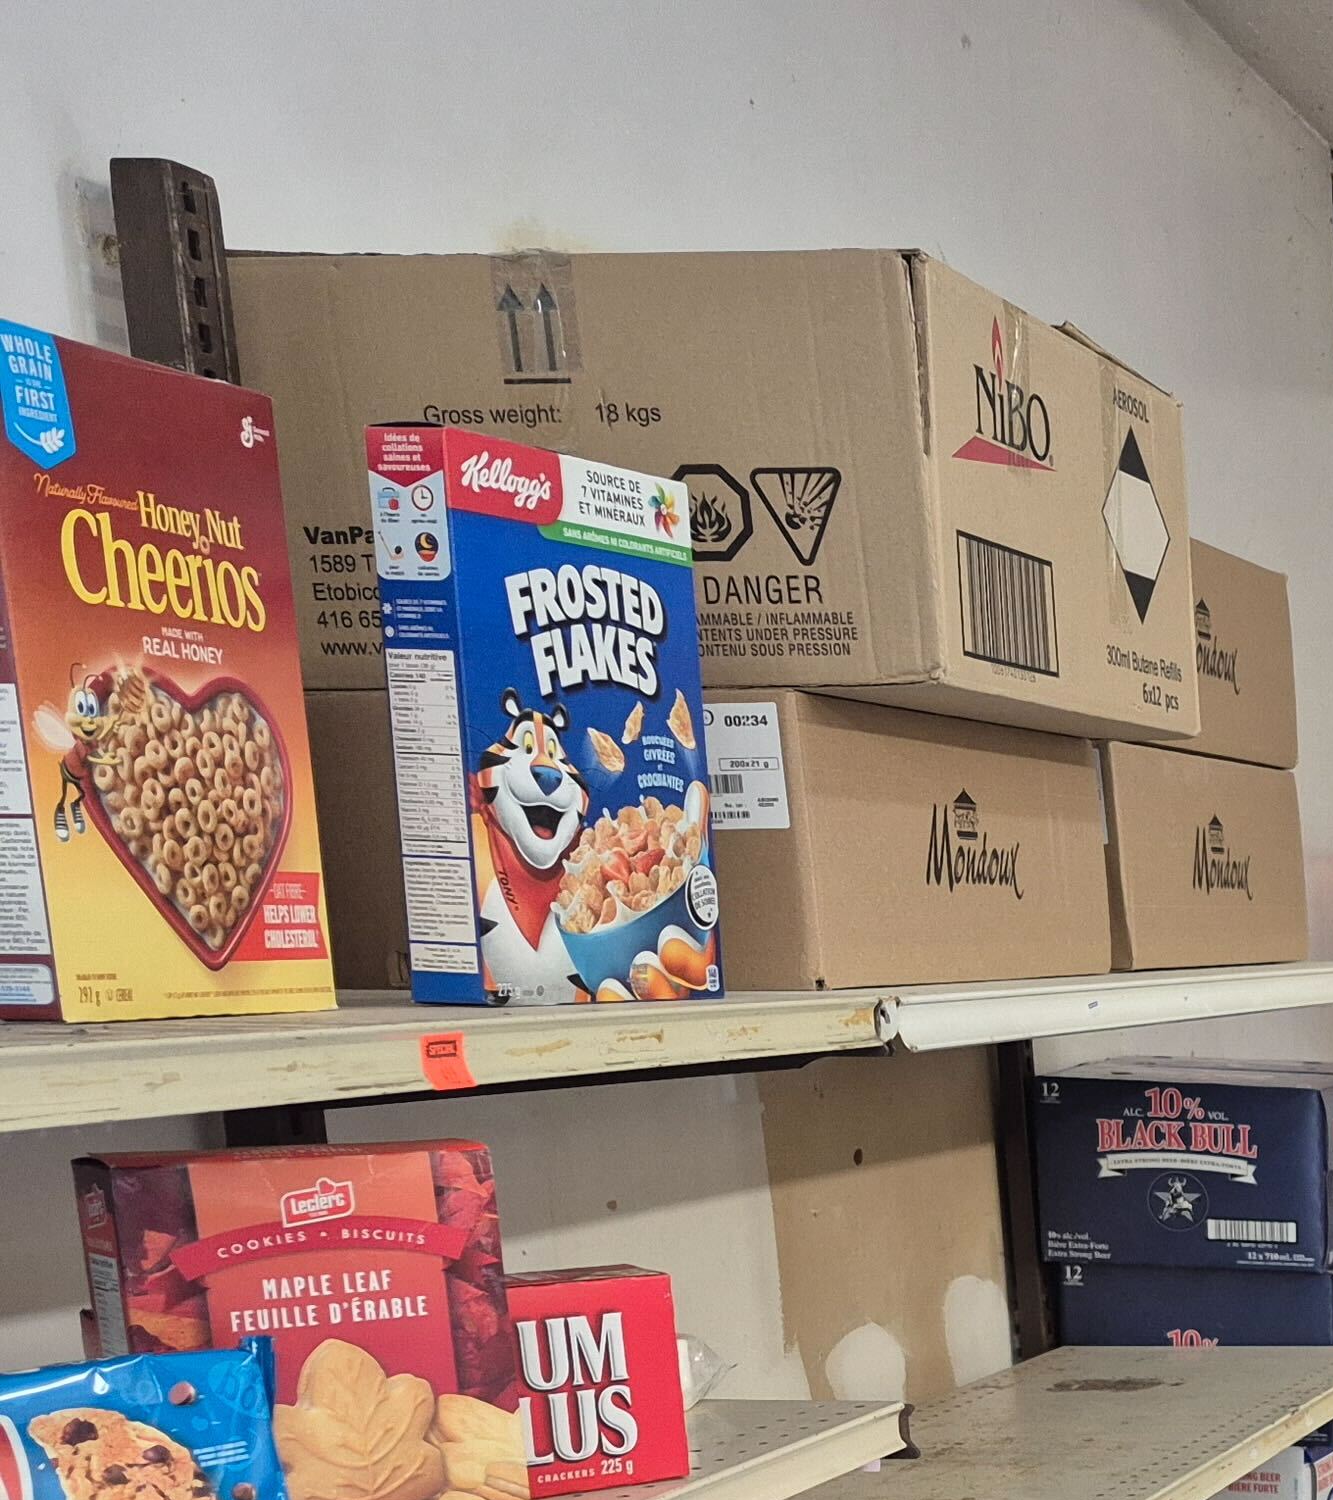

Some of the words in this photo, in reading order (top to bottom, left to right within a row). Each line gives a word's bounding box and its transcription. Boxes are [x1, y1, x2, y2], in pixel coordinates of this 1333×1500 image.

[1, 333, 52, 364] WHOLE
[9, 354, 52, 381] GRAIN
[15, 387, 55, 411] FIRST
[1112, 388, 1150, 424] AEROSOL
[423, 404, 485, 425] Gross
[489, 404, 562, 427] weight:
[595, 405, 619, 423] 18
[626, 403, 662, 426] kgs
[461, 451, 552, 510] Kellogg's
[586, 470, 624, 491] SOURCE
[627, 480, 641, 494] DE
[137, 490, 200, 548] Honey
[205, 507, 244, 550] Nut
[61, 508, 266, 632] Cheerios
[309, 555, 361, 574] 1589
[504, 564, 664, 636] FROSTED
[703, 575, 823, 605] DANGER
[317, 611, 357, 630] 416
[747, 627, 789, 641] UNDER
[793, 627, 858, 641] PRESSURE
[143, 636, 179, 660] REAL
[182, 640, 223, 665] HONEY
[530, 622, 657, 696] FLAKES
[698, 644, 746, 656] ONTENU
[751, 644, 784, 656] SOUS
[789, 643, 851, 656] PRESSION
[1106, 644, 1130, 672] 300ml
[1132, 650, 1158, 678] Butane
[1160, 656, 1182, 683] Refills
[1143, 682, 1161, 707] 6x12
[1165, 692, 1179, 712] pcs
[724, 714, 768, 727] 00234
[926, 797, 1024, 899] Mondoux
[1192, 842, 1254, 899] Mondoux
[1041, 1083, 1060, 1096] 12
[1097, 1119, 1185, 1152] BLACK
[1190, 1122, 1258, 1159] BULL
[291, 1192, 345, 1215] Leclerc
[217, 1231, 306, 1258] COOKIES
[341, 1228, 425, 1245] BISCUITS
[262, 1274, 333, 1300] MAPLE
[343, 1270, 392, 1293] LEAF
[230, 1305, 319, 1332] FEUILLE
[329, 1296, 428, 1324] D'ÉRABLE
[537, 1467, 595, 1484] CRACKERS
[600, 1458, 621, 1474] 225
